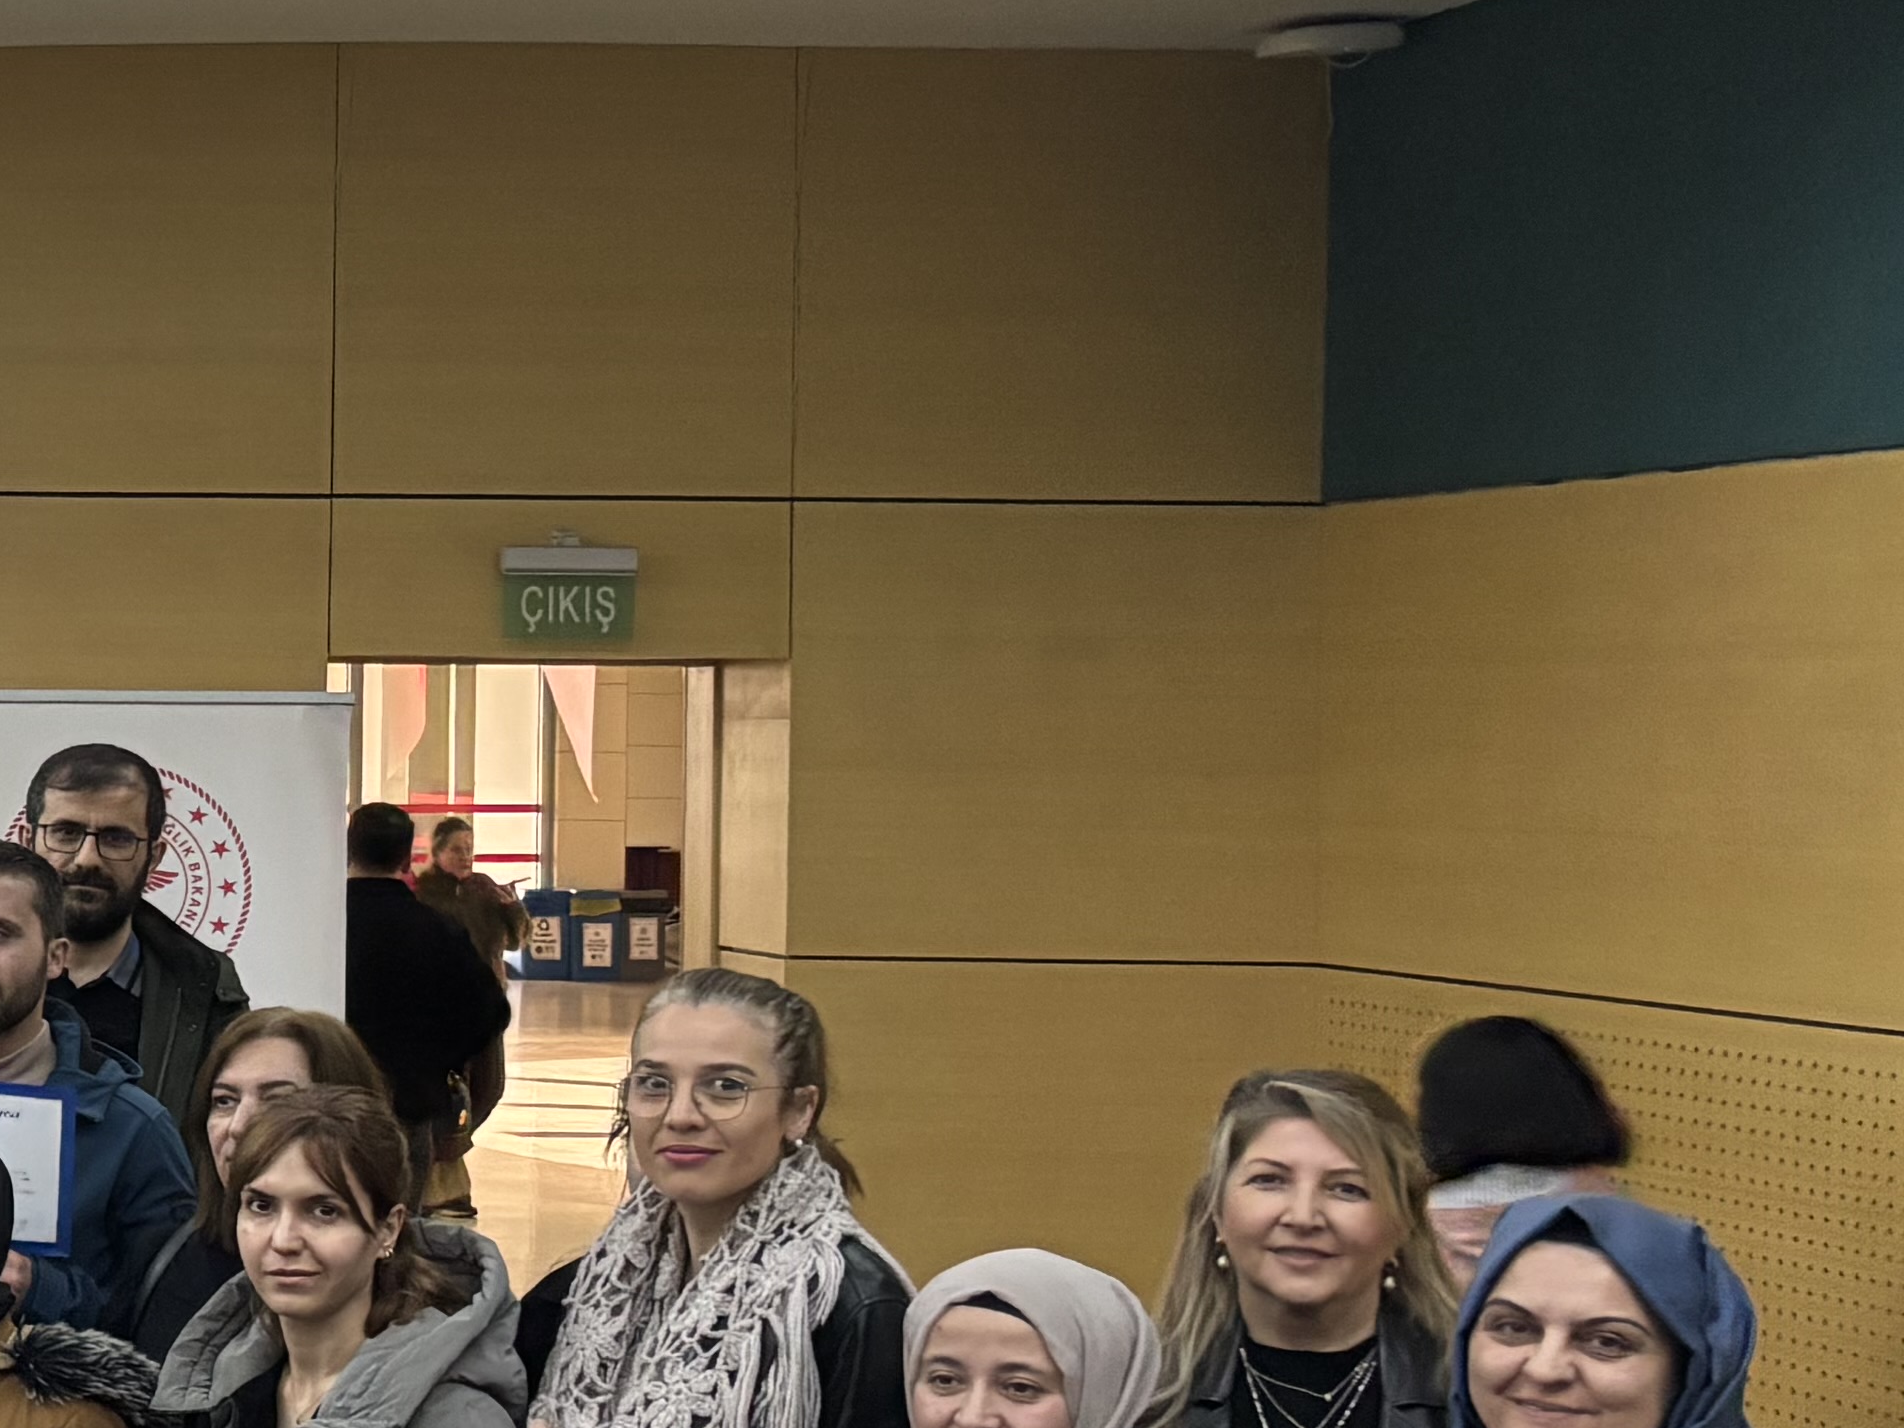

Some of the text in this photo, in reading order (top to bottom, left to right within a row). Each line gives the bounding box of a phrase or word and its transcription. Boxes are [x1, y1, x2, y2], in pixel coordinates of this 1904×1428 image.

[521, 585, 616, 633] ÇIKIŞ
[163, 821, 204, 930] ĞLIK BAKANL
